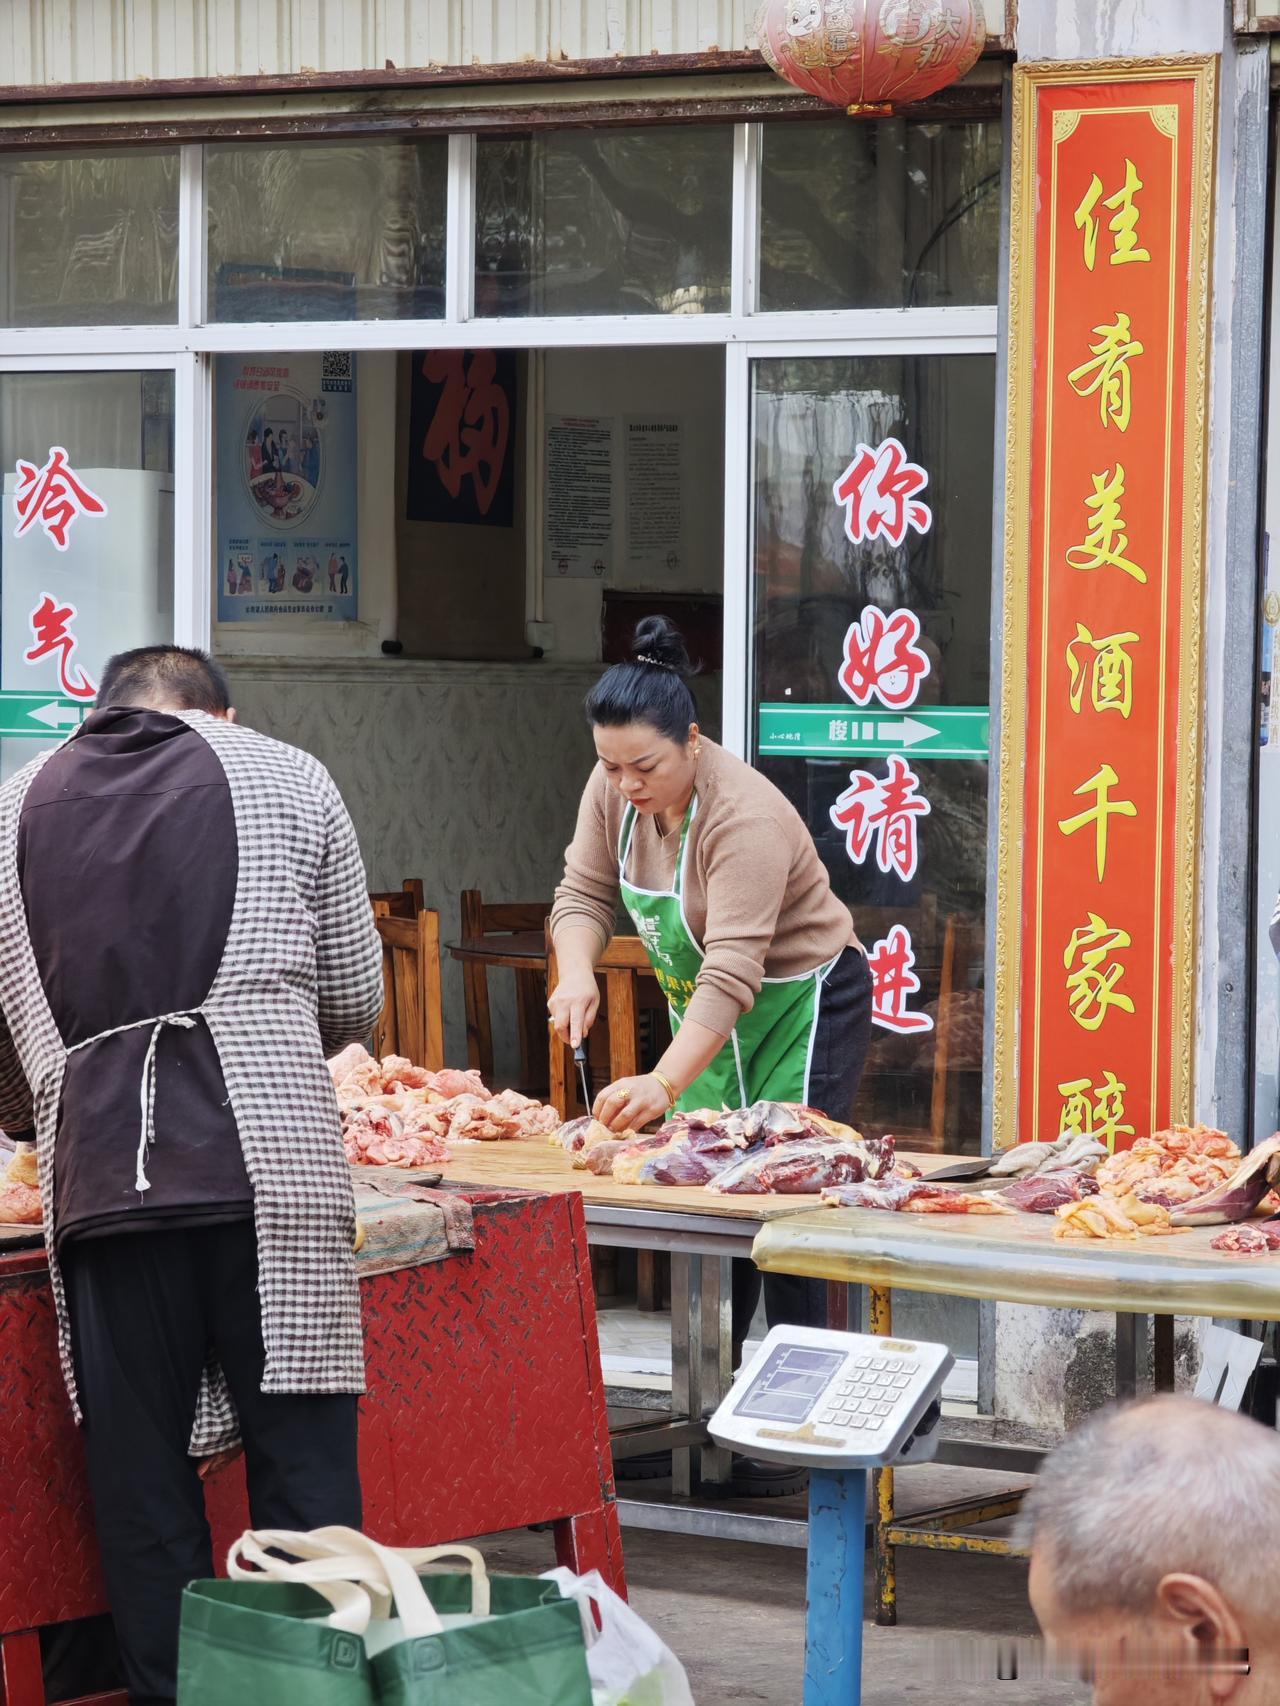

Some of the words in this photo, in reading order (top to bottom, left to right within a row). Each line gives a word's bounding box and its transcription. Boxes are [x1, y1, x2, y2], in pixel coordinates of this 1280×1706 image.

[13, 447, 107, 700] 冷气
[834, 441, 932, 1033] 你好请进
[1057, 156, 1152, 1154] 佳肴美酒千家醉
